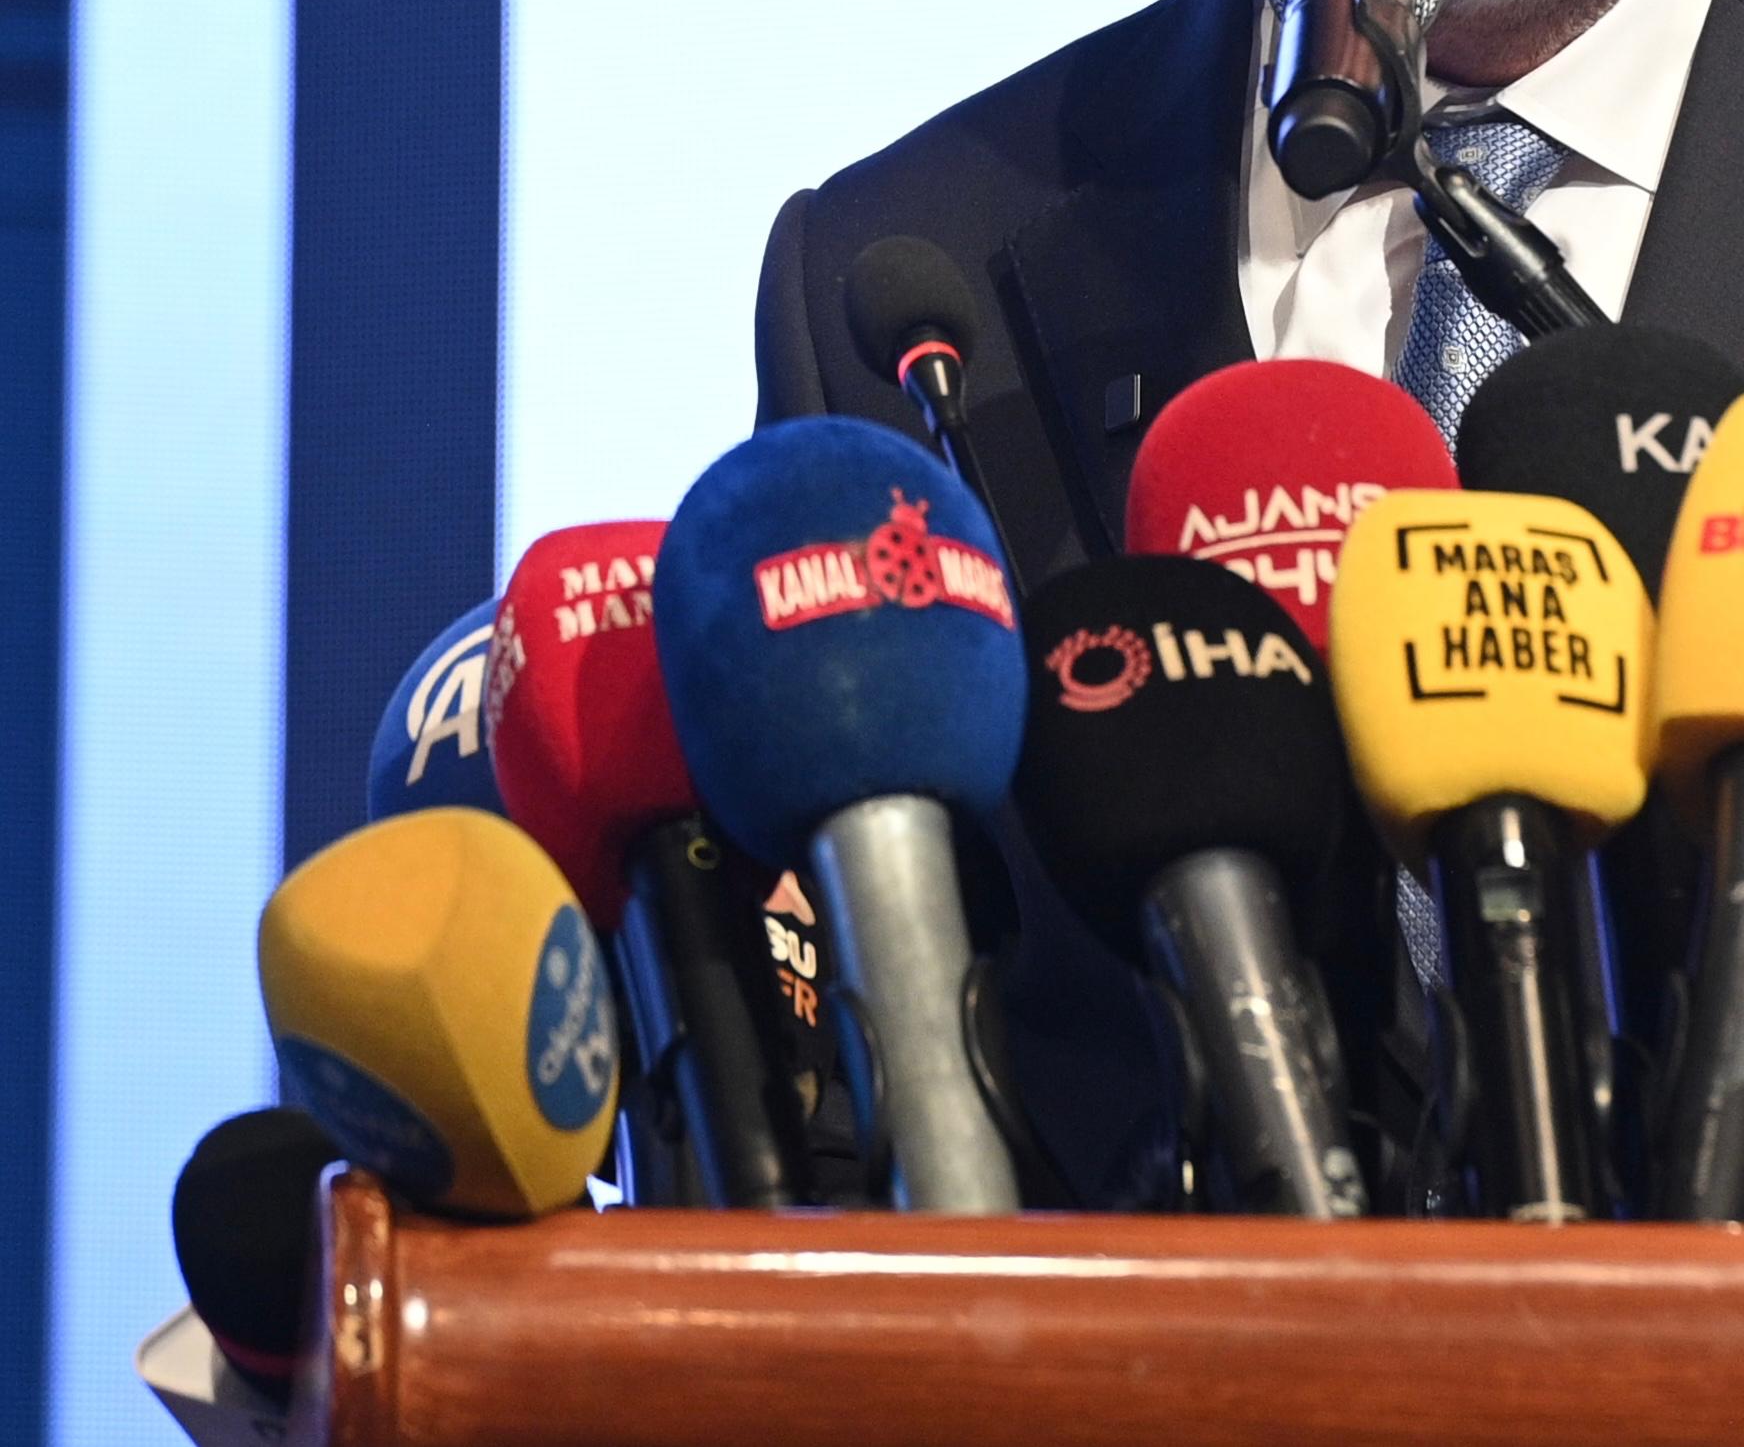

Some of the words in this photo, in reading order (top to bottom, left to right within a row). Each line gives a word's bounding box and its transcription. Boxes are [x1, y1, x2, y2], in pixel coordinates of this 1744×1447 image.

[1615, 412, 1718, 474] KA
[759, 550, 868, 621] KANAL
[1465, 580, 1566, 624] ANA
[1152, 621, 1312, 685] İHA
[1443, 626, 1592, 679] HABER
